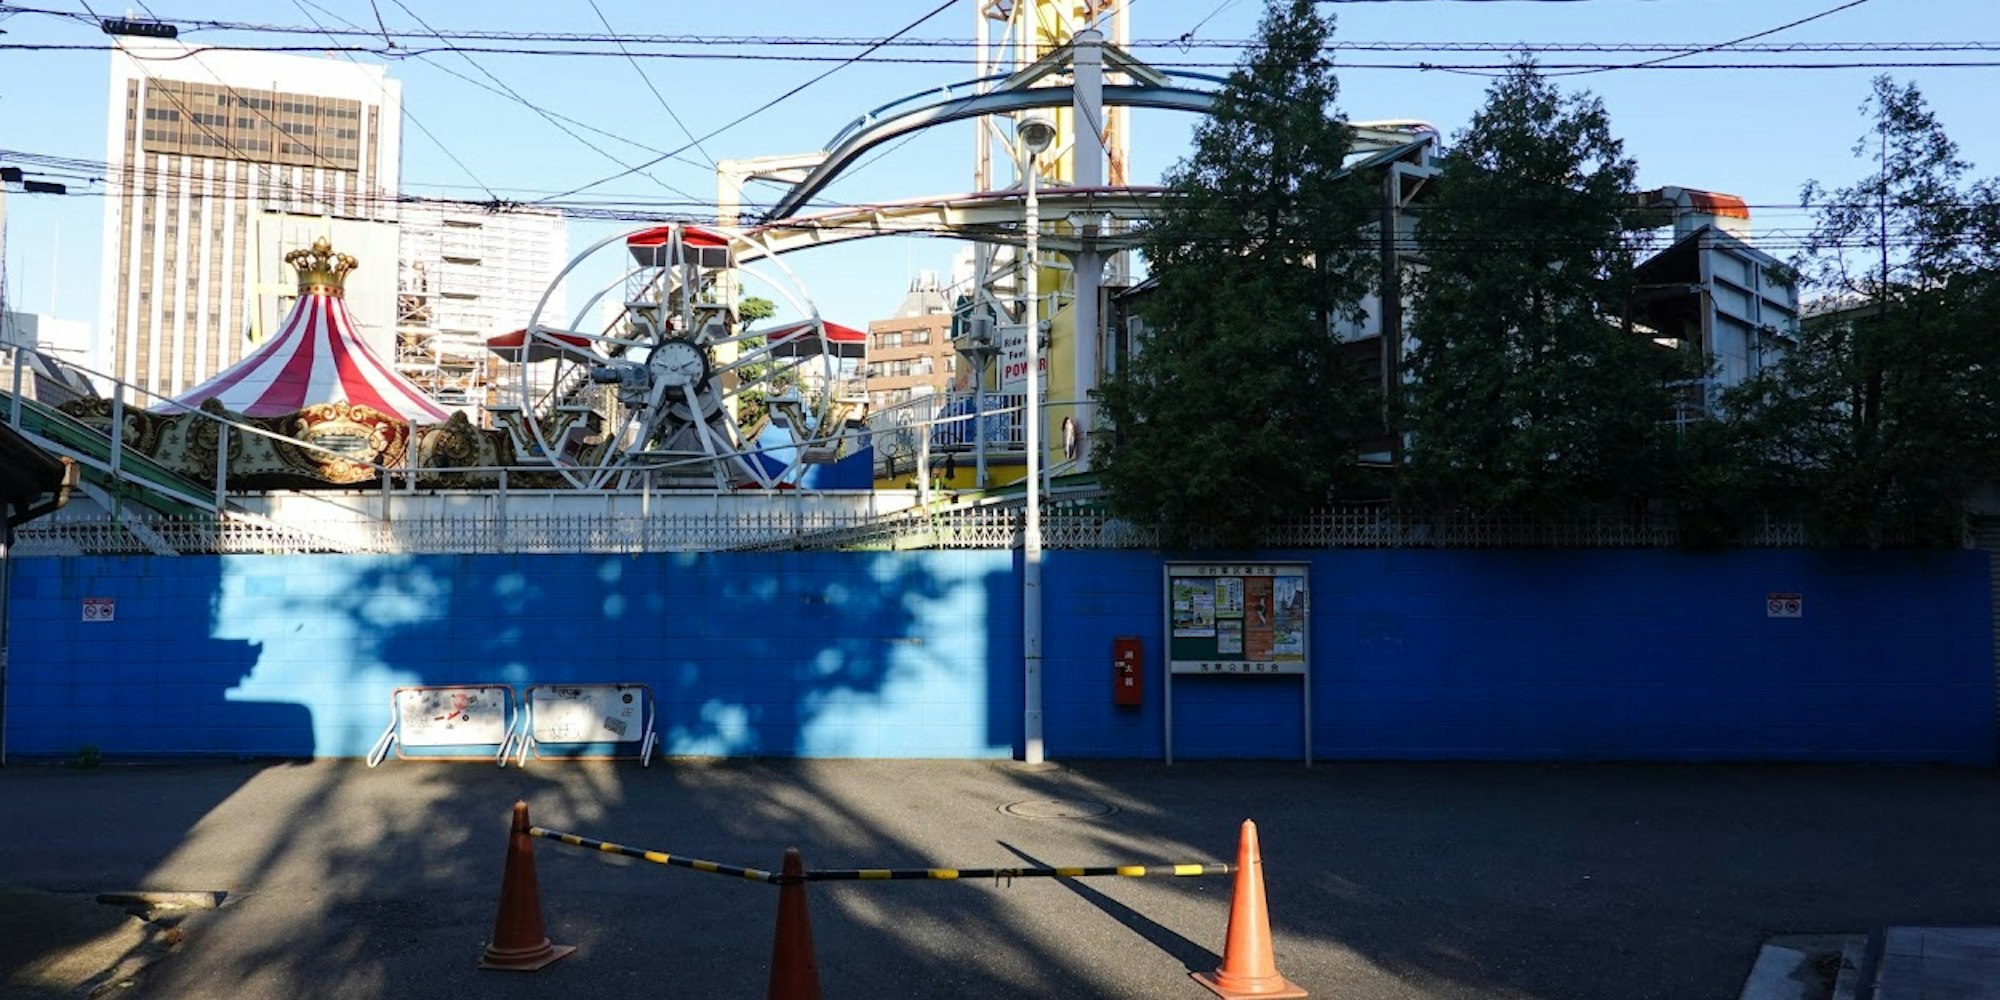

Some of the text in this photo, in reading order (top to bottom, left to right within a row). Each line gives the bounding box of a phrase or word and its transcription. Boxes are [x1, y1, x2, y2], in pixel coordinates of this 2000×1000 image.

[1004, 337, 1021, 348] Ride
[1005, 358, 1046, 379] POWR
[1124, 650, 1134, 688] 消火器
